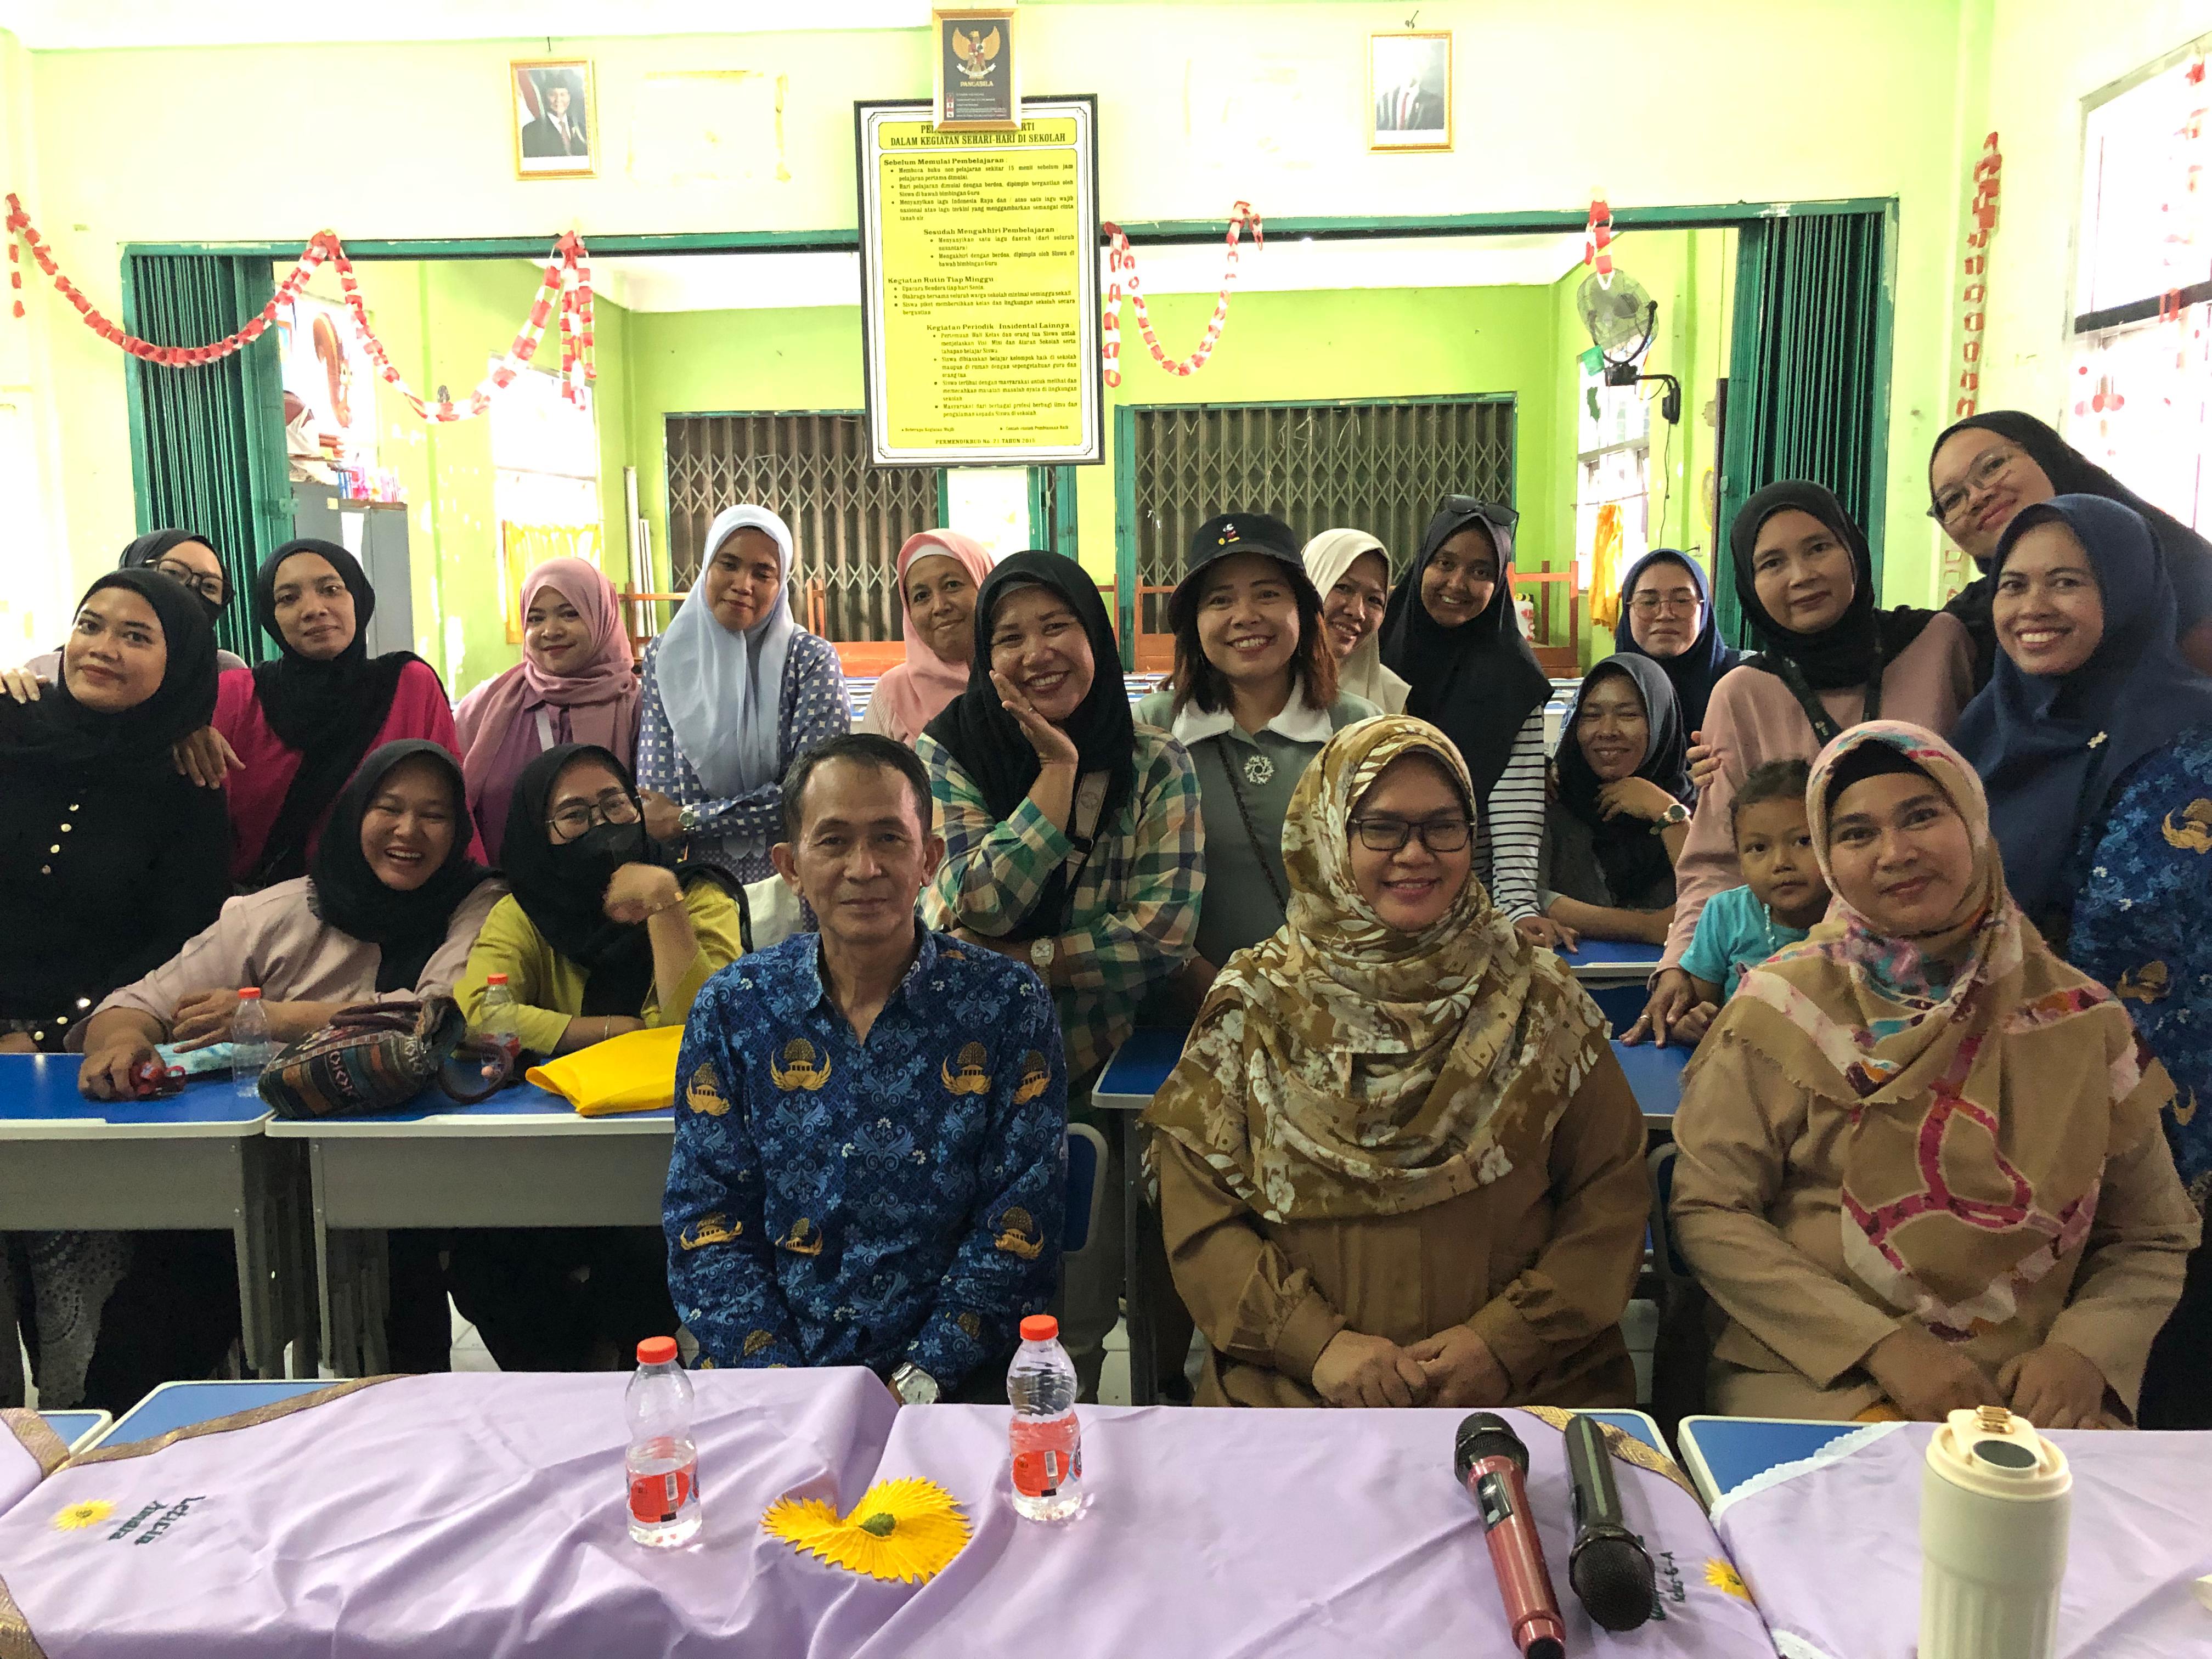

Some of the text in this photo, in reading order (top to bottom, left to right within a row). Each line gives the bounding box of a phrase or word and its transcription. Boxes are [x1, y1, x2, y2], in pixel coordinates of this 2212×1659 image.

[890, 133, 1065, 146] DALAM KEGIATAN SEHARI-HARI DI SEKOLAH
[952, 157, 1003, 165] Pembelajaran
[957, 227, 1001, 235] Mengakhiri
[1002, 226, 1054, 235] Pembelajaran
[965, 275, 993, 284] Minggu
